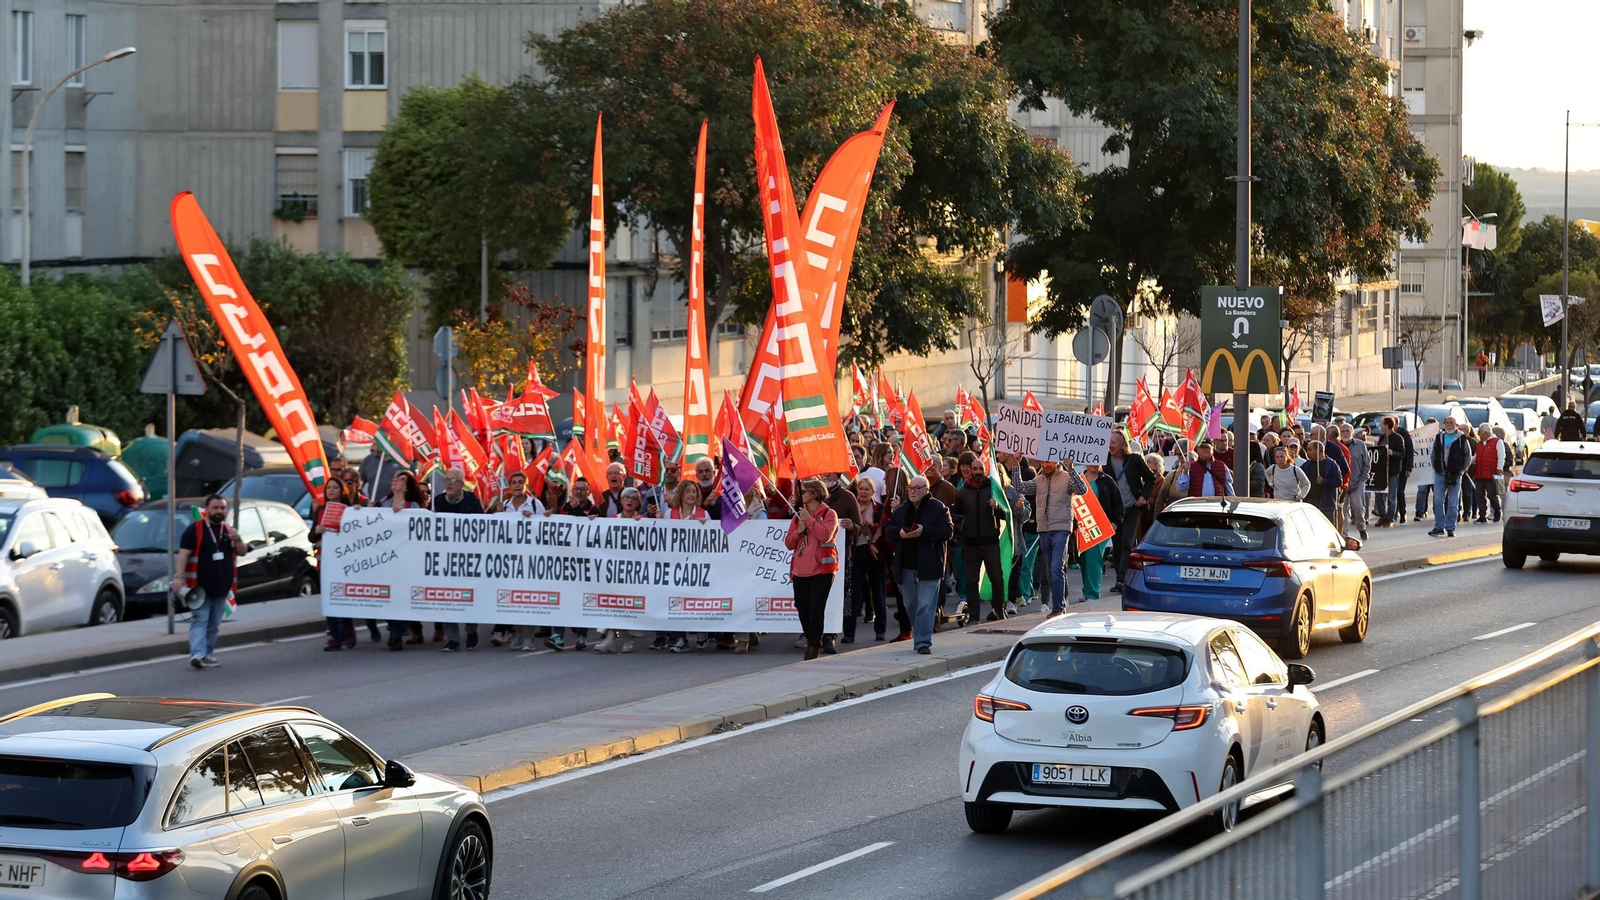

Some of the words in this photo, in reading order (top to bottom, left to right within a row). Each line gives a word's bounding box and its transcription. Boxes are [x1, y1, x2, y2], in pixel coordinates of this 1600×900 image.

[1218, 297, 1264, 308] NUEVO
[997, 430, 1038, 456] PÚBLIC
[1045, 430, 1058, 441] LA
[1062, 432, 1106, 446] SANIDAD
[1048, 447, 1100, 463] PÚBLICA
[366, 512, 384, 525] LA
[408, 517, 430, 541] POR
[435, 518, 449, 542] EL
[453, 520, 512, 544] HOSPITAL
[517, 521, 532, 544] DE
[536, 521, 570, 547] JEREZ
[576, 524, 585, 547] Y
[586, 525, 602, 548] LA
[604, 520, 666, 552] ATENCIÓN
[671, 528, 729, 553] PRIMARIA
[335, 530, 392, 558] SANIDAD
[343, 550, 398, 576] PÚBLICA
[425, 552, 440, 576] DE
[443, 552, 481, 578] JEREZ
[486, 554, 524, 579] COSTA
[528, 555, 590, 582] NOROESTE
[594, 559, 603, 582] Y
[605, 560, 649, 584] SIERRA
[654, 562, 669, 585] DE
[673, 557, 711, 587] CÁDIZ
[756, 566, 777, 581] DEL
[1184, 568, 1205, 577] 1521
[1209, 570, 1228, 579] MJN
[346, 585, 380, 596] CCOO
[427, 589, 462, 599] CCOO
[513, 592, 548, 603] CCOO
[600, 596, 634, 606] CCOO
[686, 600, 721, 609] CCOO
[1069, 734, 1092, 742] Albia
[1043, 767, 1073, 780] 9051
[1082, 768, 1106, 782] LLK
[8, 865, 41, 882] NHF
